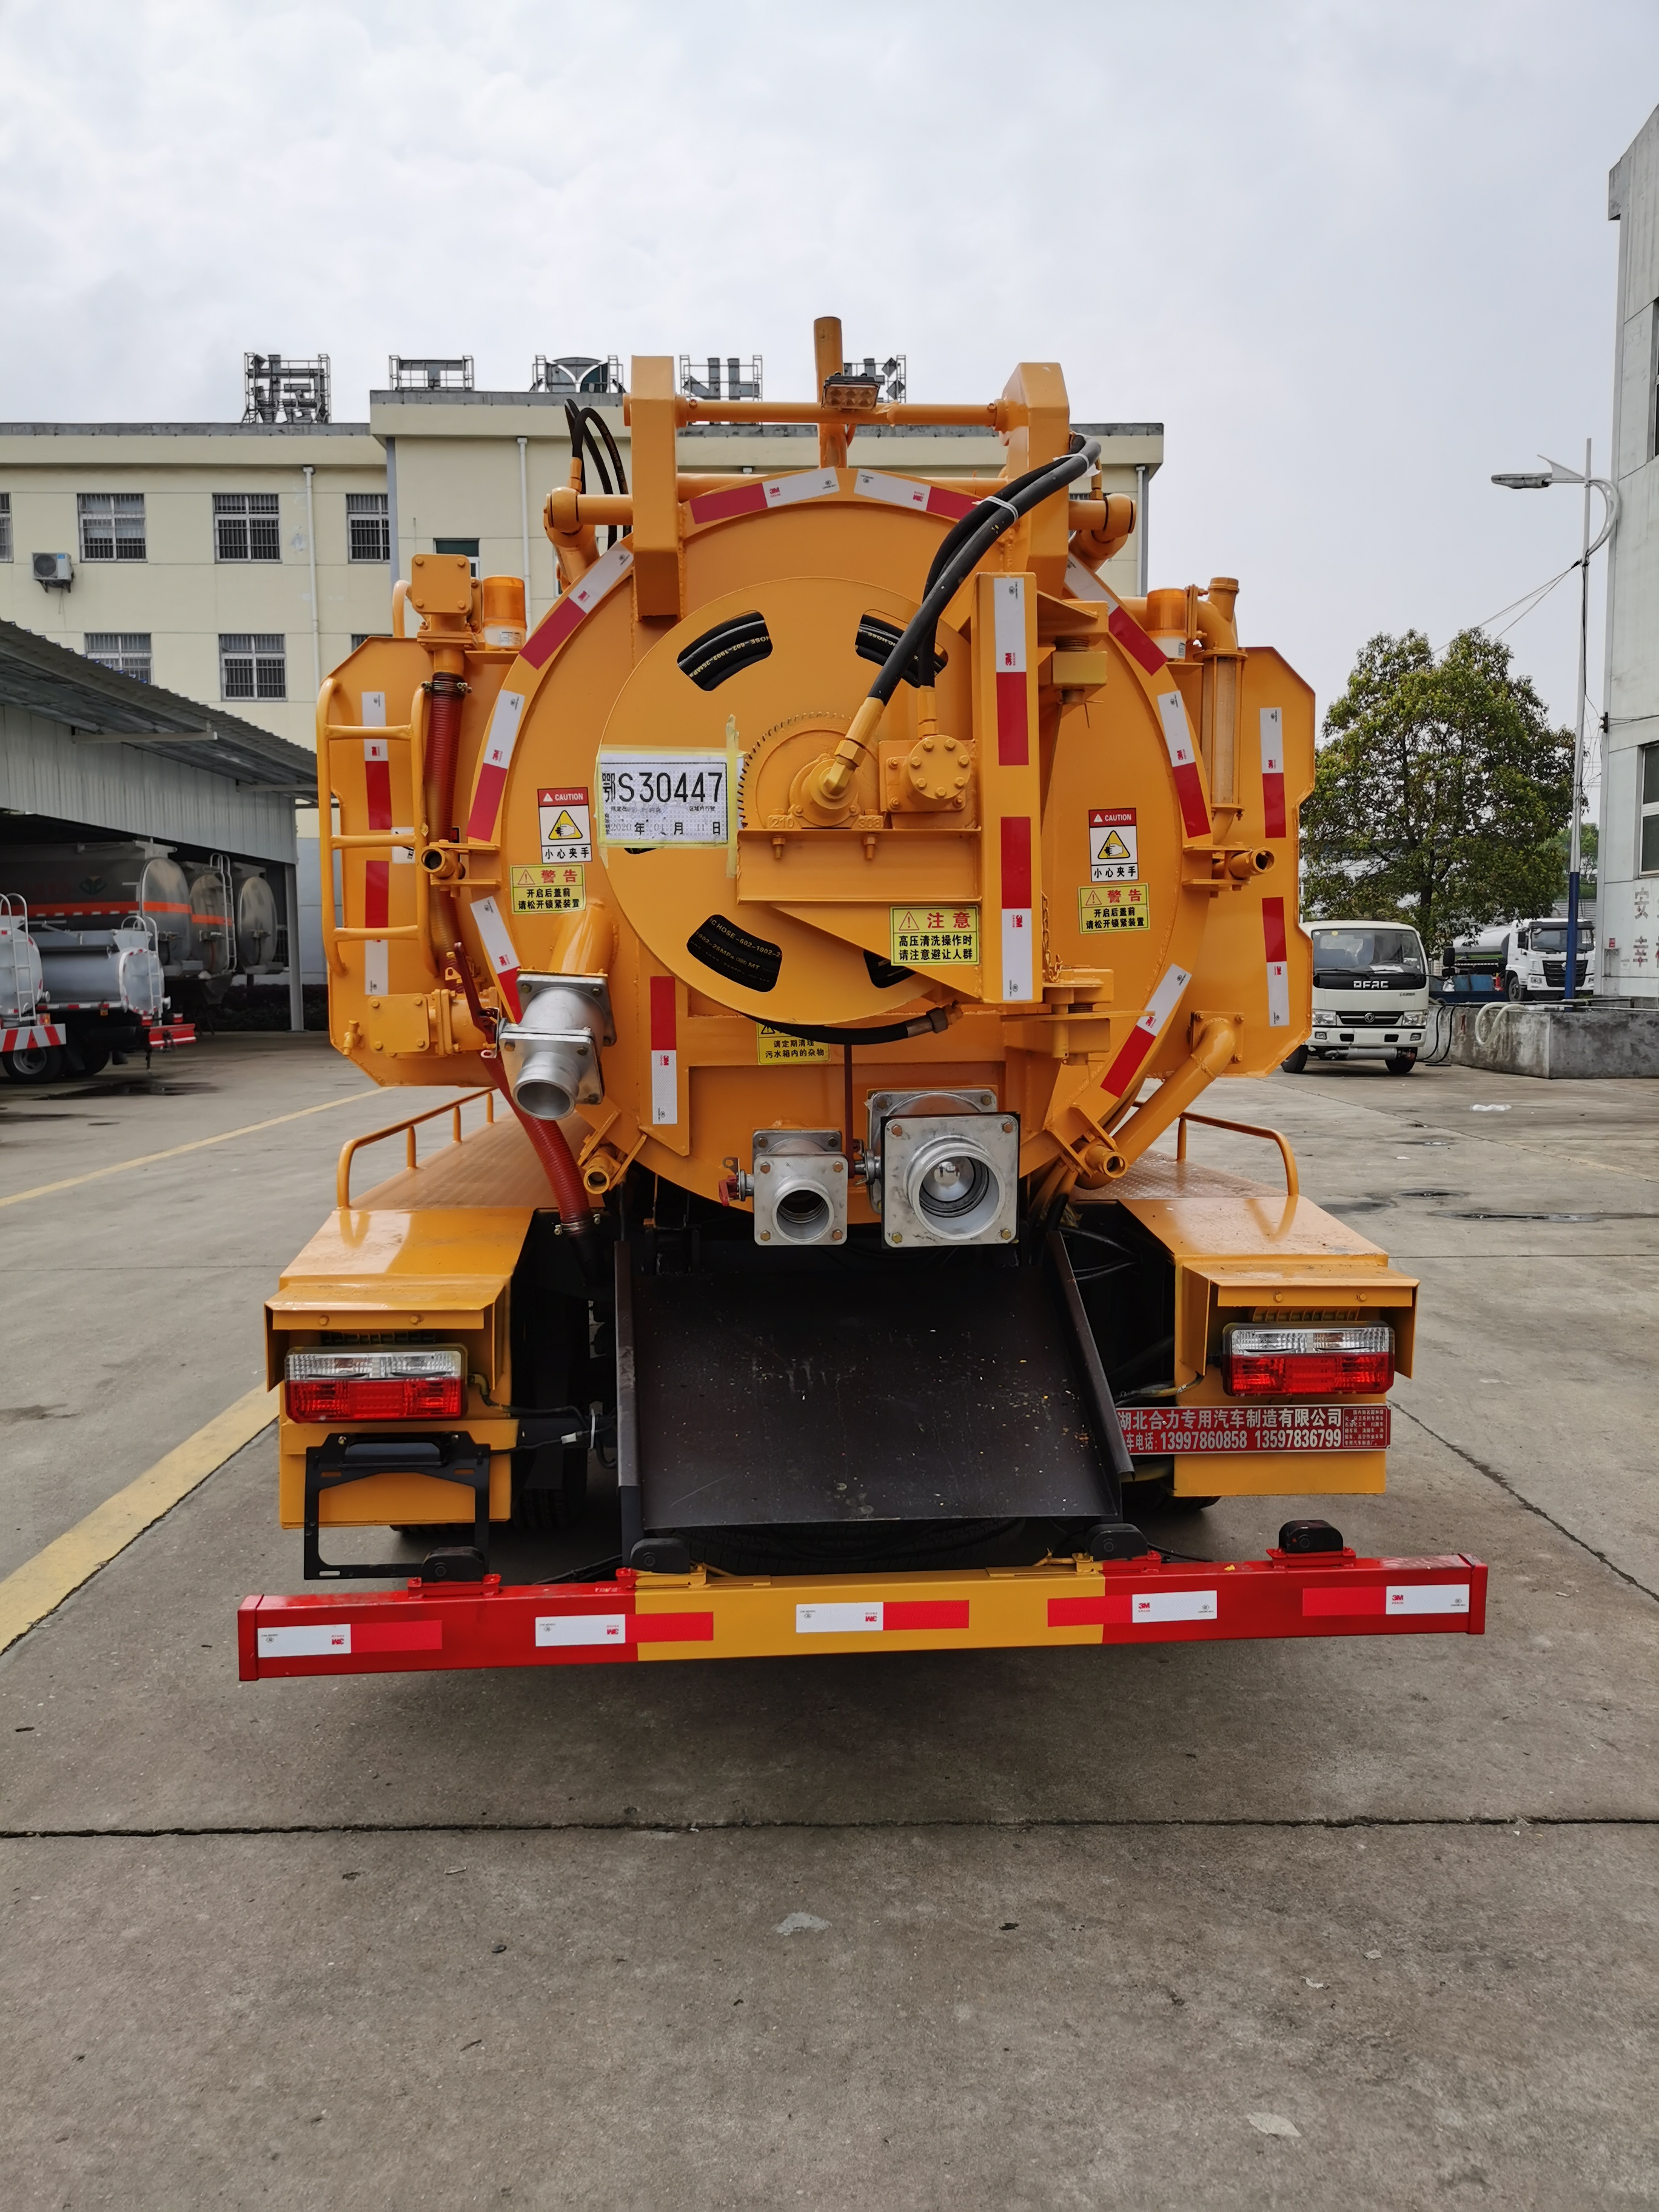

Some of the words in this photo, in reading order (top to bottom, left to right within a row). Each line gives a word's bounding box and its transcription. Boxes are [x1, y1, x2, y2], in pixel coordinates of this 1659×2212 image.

[1005, 653, 1011, 665] 3M
[602, 772, 723, 803] 鄂S30447
[611, 823, 632, 831] 2020
[634, 822, 645, 836] 年
[674, 822, 683, 836] 月
[712, 822, 720, 835] 日
[771, 817, 795, 828] 210
[545, 847, 589, 860] 小心夹手
[541, 869, 578, 884] 警告
[1094, 866, 1136, 879] 小心夹手
[526, 888, 571, 899] 开启后盖前
[1107, 889, 1142, 903] 警告
[518, 899, 580, 910] 请松开锁紧装置
[1094, 907, 1136, 918] 开启后盖前
[927, 911, 971, 929] 注意
[1016, 915, 1022, 928] 3M
[1086, 917, 1144, 930] 请松开锁紧装置
[716, 923, 736, 939] HOSE
[736, 937, 783, 958] -602-1902-2
[899, 934, 973, 947] 高压清洗操作时
[899, 948, 973, 960] 请注意避让人群
[1353, 980, 1389, 989] DFAC
[773, 1039, 814, 1048] 请定期清理
[663, 1055, 669, 1065] 3M
[765, 1048, 825, 1059] 污水箱内的杂物
[1118, 1408, 1342, 1430] 湖北合力专用汽车制造有限公司
[1124, 1432, 1158, 1451] 车电话:
[1161, 1430, 1247, 1450] 13997860858
[1255, 1429, 1341, 1448] 13597836799
